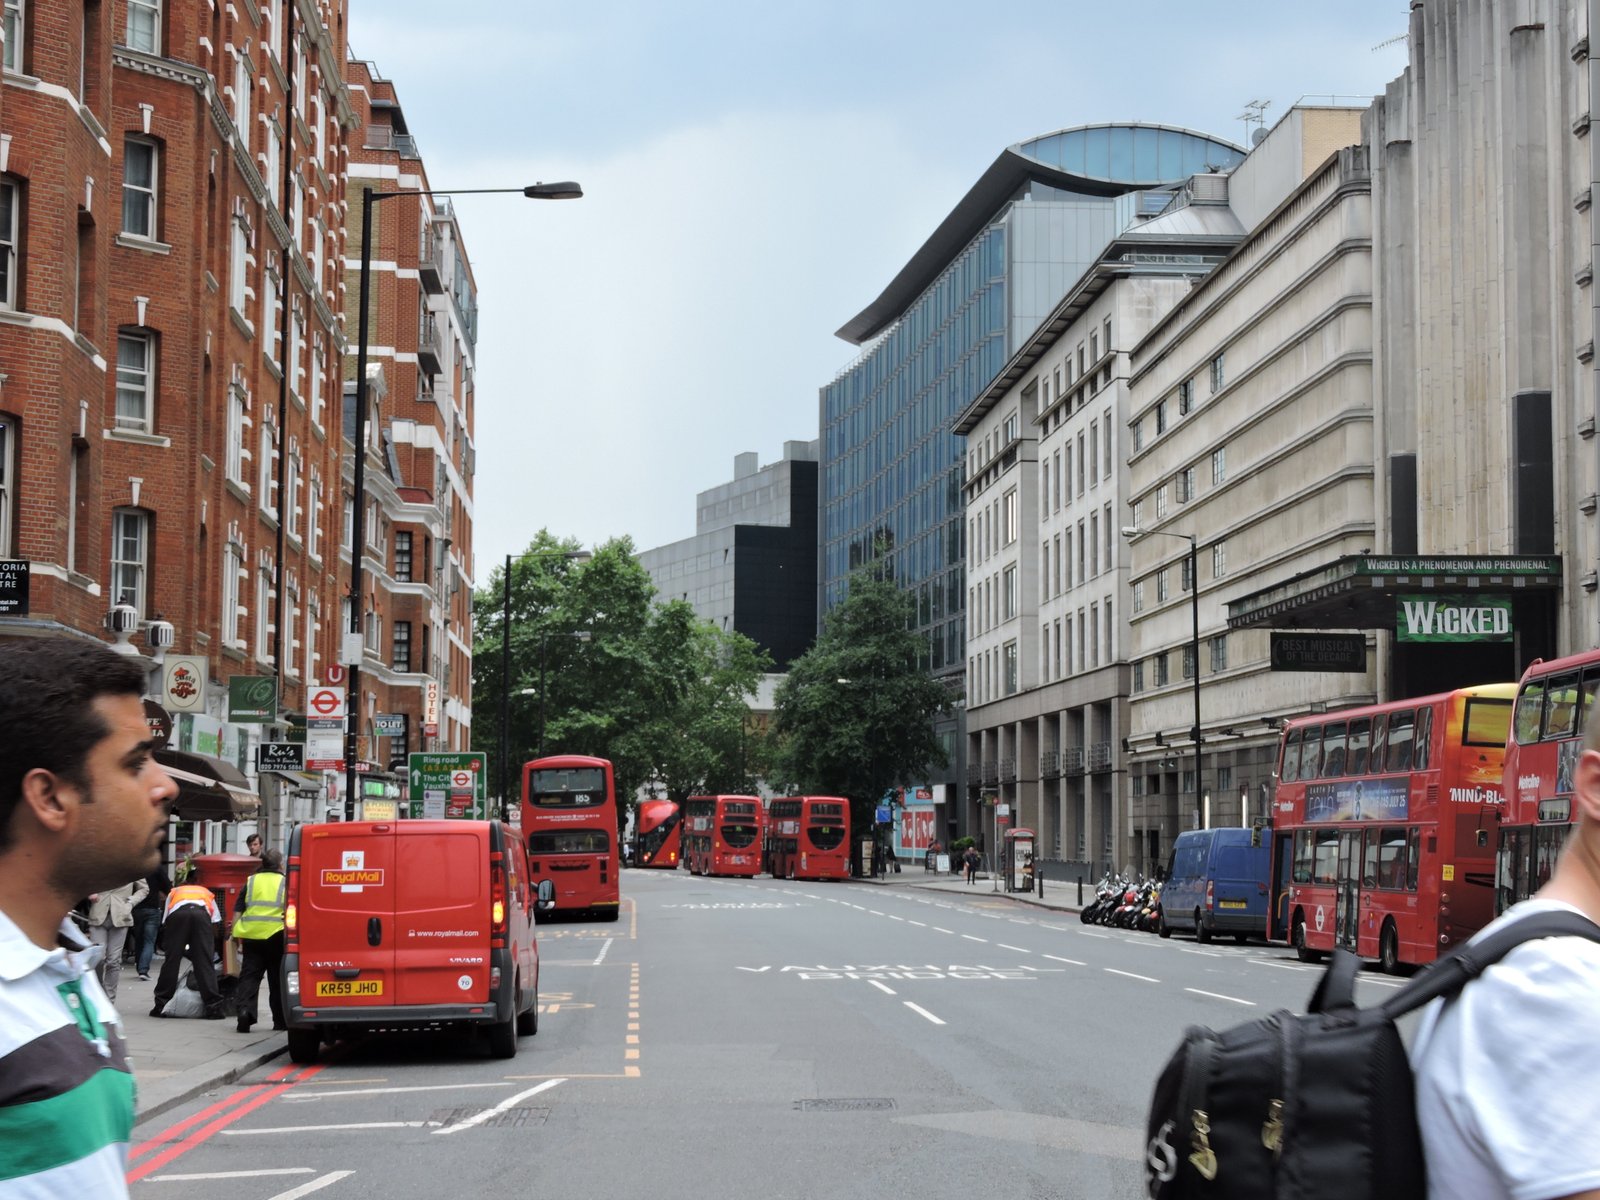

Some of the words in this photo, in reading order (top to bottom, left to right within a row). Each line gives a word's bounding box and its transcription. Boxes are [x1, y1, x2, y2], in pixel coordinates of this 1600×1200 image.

[0, 563, 27, 571] ORIA
[1402, 560, 1410, 570] IS
[1411, 560, 1417, 570] A
[1419, 560, 1474, 570] PHENOMENON
[1475, 560, 1492, 570] AND
[1282, 639, 1307, 651] BEST
[1310, 639, 1355, 652] MUSICAL
[1286, 651, 1296, 660] OF
[1301, 651, 1317, 661] THE
[1318, 651, 1352, 661] DECADE
[329, 667, 342, 682] U
[428, 683, 437, 723] HOTEL
[376, 720, 388, 729] TO
[388, 720, 401, 729] LET
[268, 744, 295, 757] Ru's
[423, 756, 440, 764] Ring
[325, 872, 355, 884] Royal
[356, 871, 380, 882] Mail
[417, 930, 479, 938] www.royalmail.com
[320, 983, 352, 995] KR59
